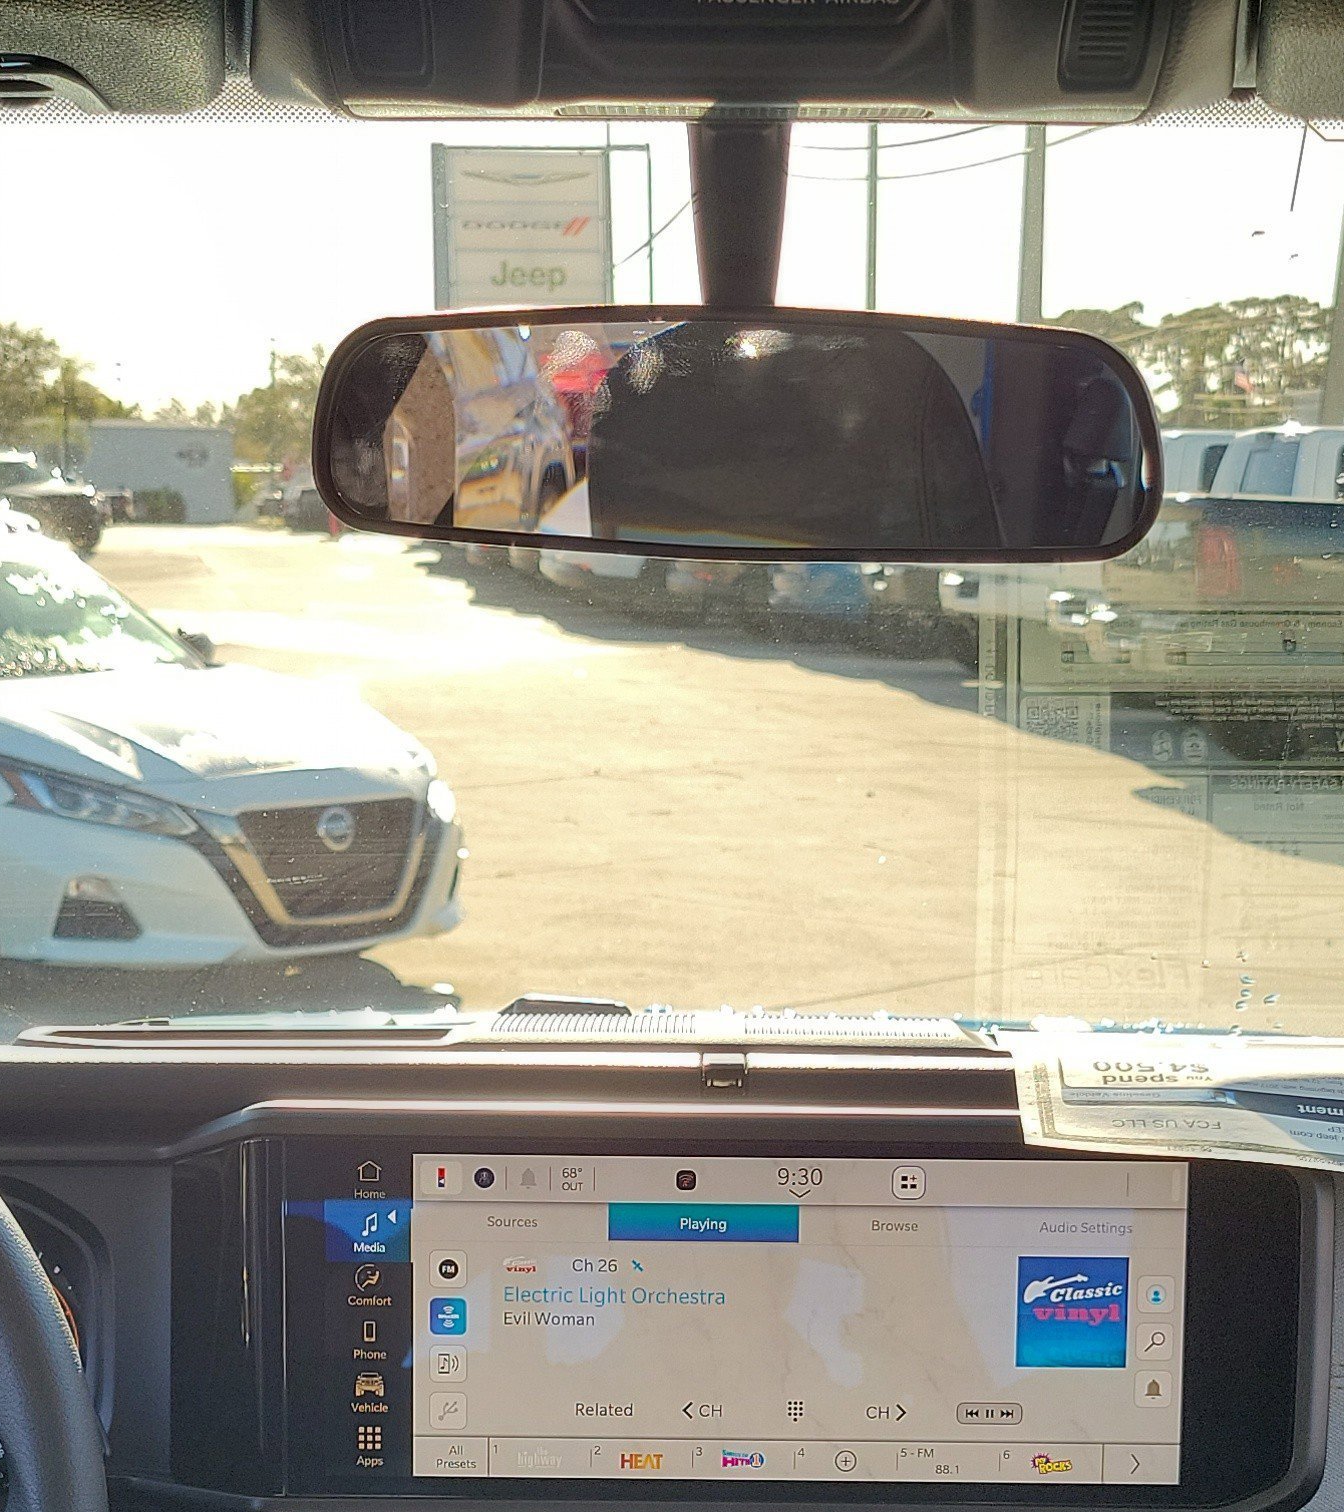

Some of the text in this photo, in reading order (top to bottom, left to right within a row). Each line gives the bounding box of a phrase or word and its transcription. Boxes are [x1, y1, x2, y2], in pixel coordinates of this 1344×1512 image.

[490, 261, 566, 293] Jeep
[1101, 1074, 1179, 1085] spend
[1112, 1119, 1222, 1130] FCA US LLC
[562, 1167, 583, 1180] 68°
[777, 1167, 823, 1186] 9:30
[562, 1181, 583, 1192] OUT
[354, 1188, 386, 1200] Home
[487, 1216, 538, 1228] Sources
[679, 1218, 727, 1233] Playing
[871, 1220, 919, 1233] Browse
[1039, 1222, 1133, 1236] Audio Settings
[353, 1242, 386, 1254] Media
[442, 1264, 455, 1274] FM
[506, 1264, 537, 1275] vinyl
[572, 1259, 618, 1273] Ch 26
[503, 1287, 726, 1307] Electric Light Orchestra
[1050, 1282, 1123, 1304] Classic
[348, 1295, 392, 1307] Comfort
[504, 1312, 595, 1327] Evil Woman
[1032, 1304, 1121, 1326] vinyl
[353, 1349, 387, 1361] Phone
[351, 1402, 389, 1414] Vehicle
[575, 1403, 634, 1417] Related
[699, 1405, 723, 1418] CH
[866, 1406, 890, 1419] CH
[448, 1445, 464, 1456] All
[594, 1446, 601, 1455] 2
[696, 1447, 703, 1457] 3
[797, 1448, 805, 1458] 4
[900, 1449, 934, 1458] 5 FM
[1003, 1450, 1010, 1460] 6
[356, 1456, 384, 1468] Apps
[436, 1458, 477, 1470] Presets
[620, 1453, 663, 1470] HEAT
[935, 1464, 960, 1475] 88.1
